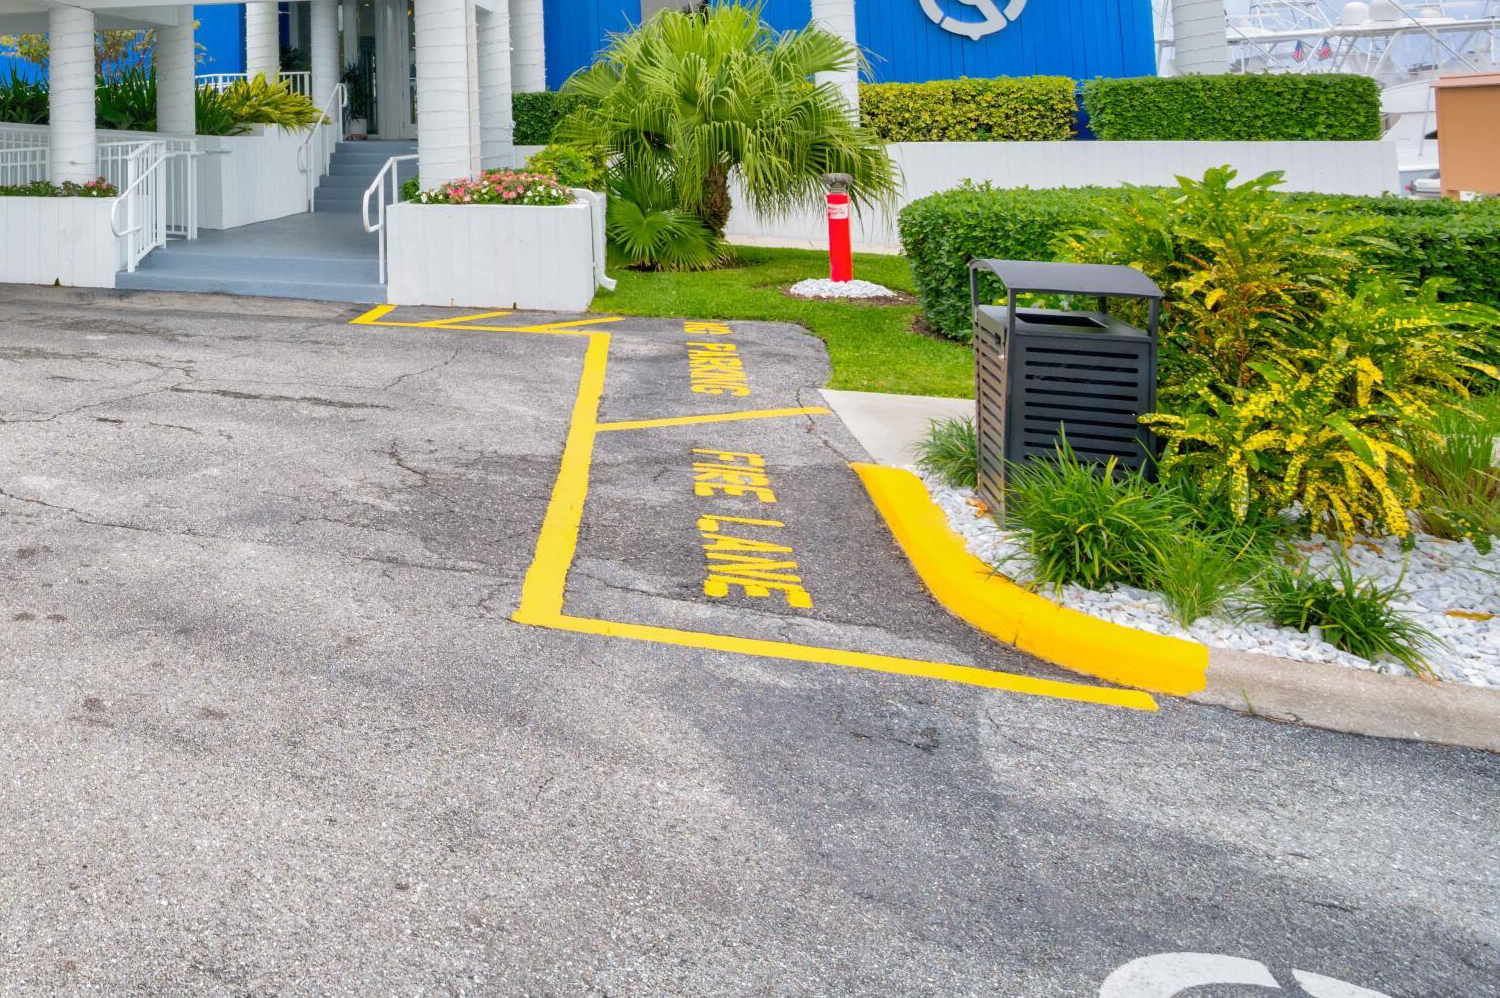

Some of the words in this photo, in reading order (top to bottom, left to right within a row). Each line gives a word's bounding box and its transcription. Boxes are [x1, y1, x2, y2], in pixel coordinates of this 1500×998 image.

[686, 341, 751, 398] PARKING
[692, 448, 777, 503] FIRE
[697, 514, 813, 609] LANE
